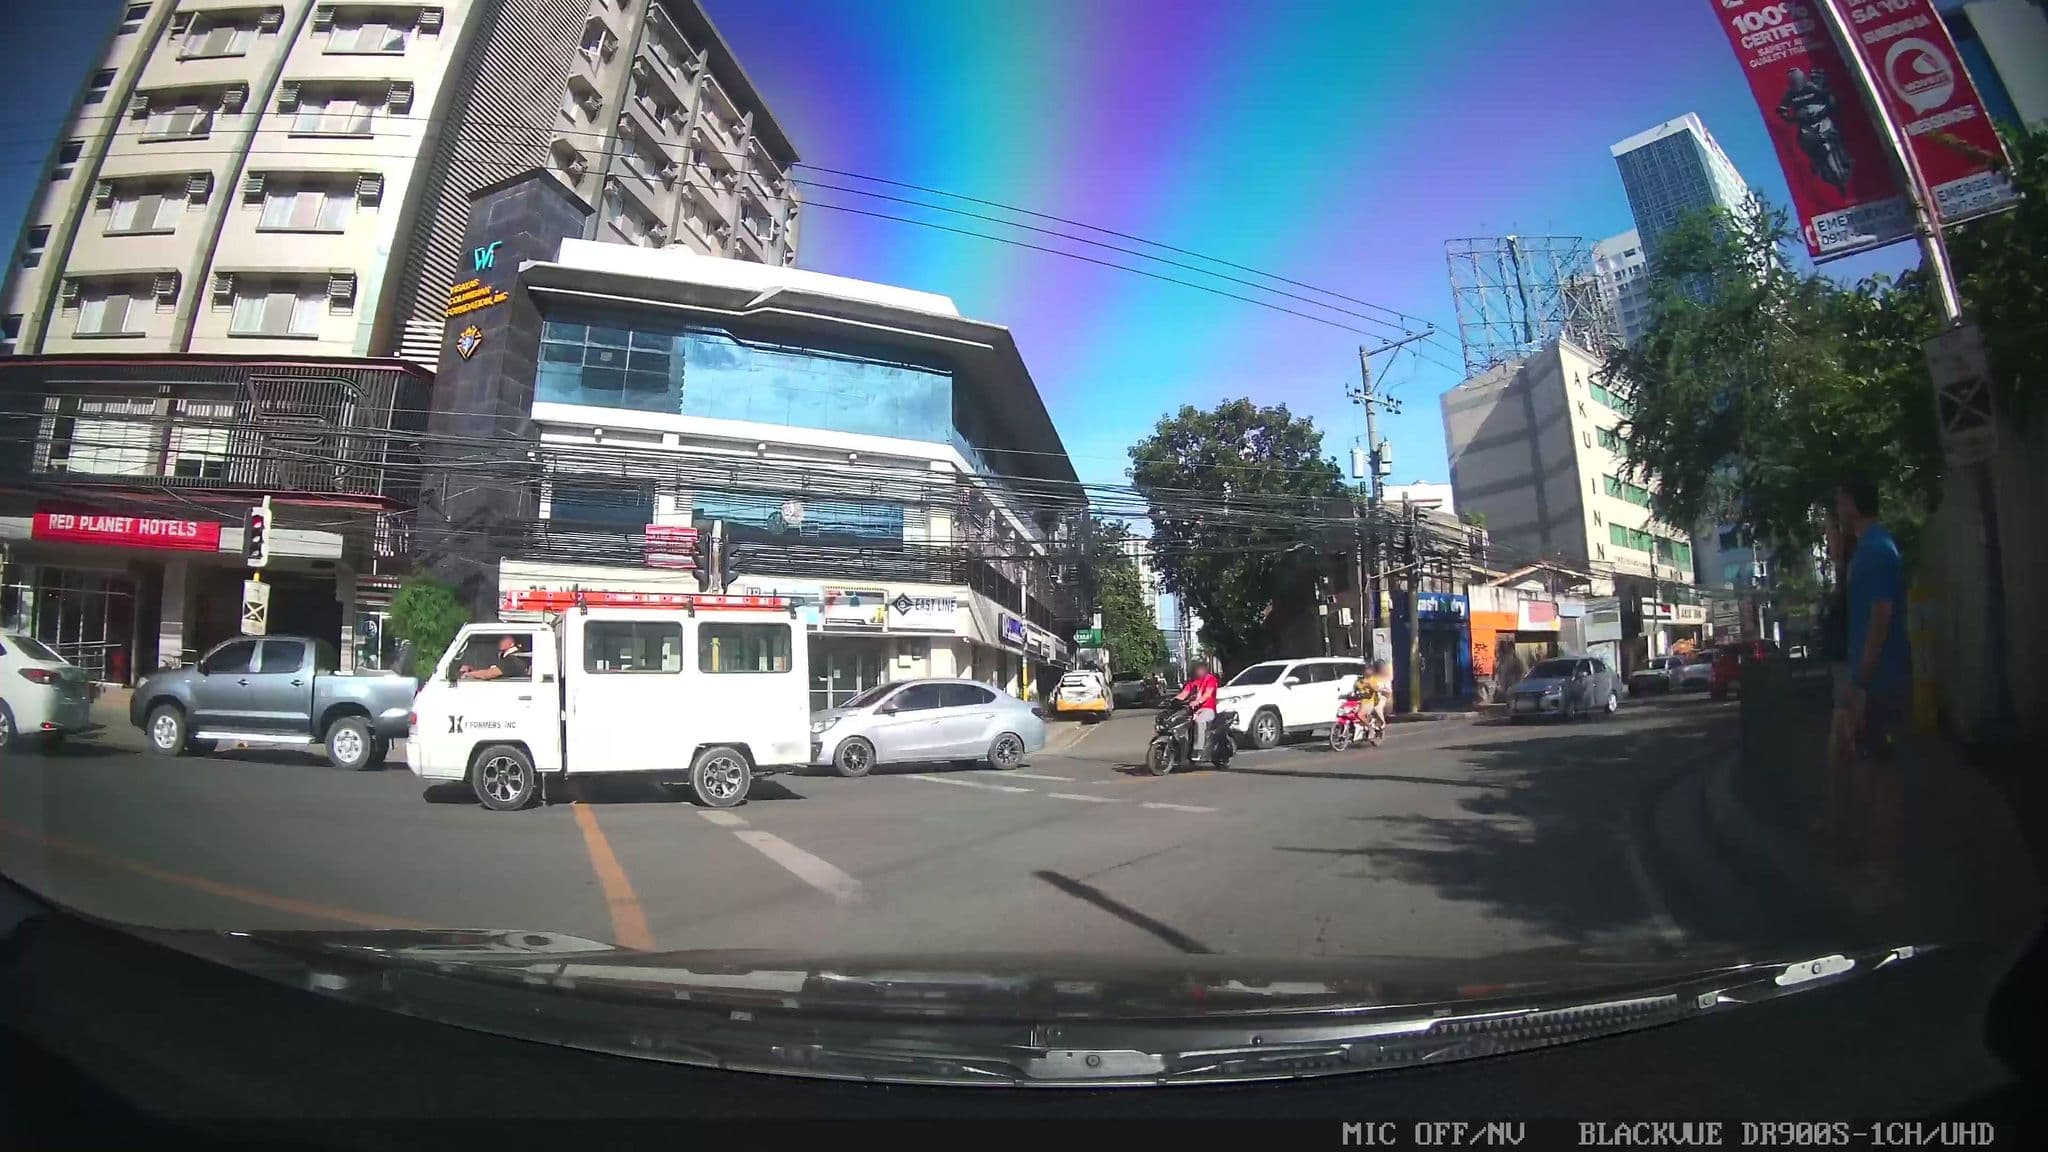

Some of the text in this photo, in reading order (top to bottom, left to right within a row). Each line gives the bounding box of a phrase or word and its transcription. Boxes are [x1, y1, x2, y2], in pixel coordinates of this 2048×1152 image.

[1741, 20, 1815, 49] CERTIFI
[49, 514, 197, 537] RED PLANET HOTELS
[915, 597, 957, 612] EAST LINE
[1416, 597, 1438, 612] ash
